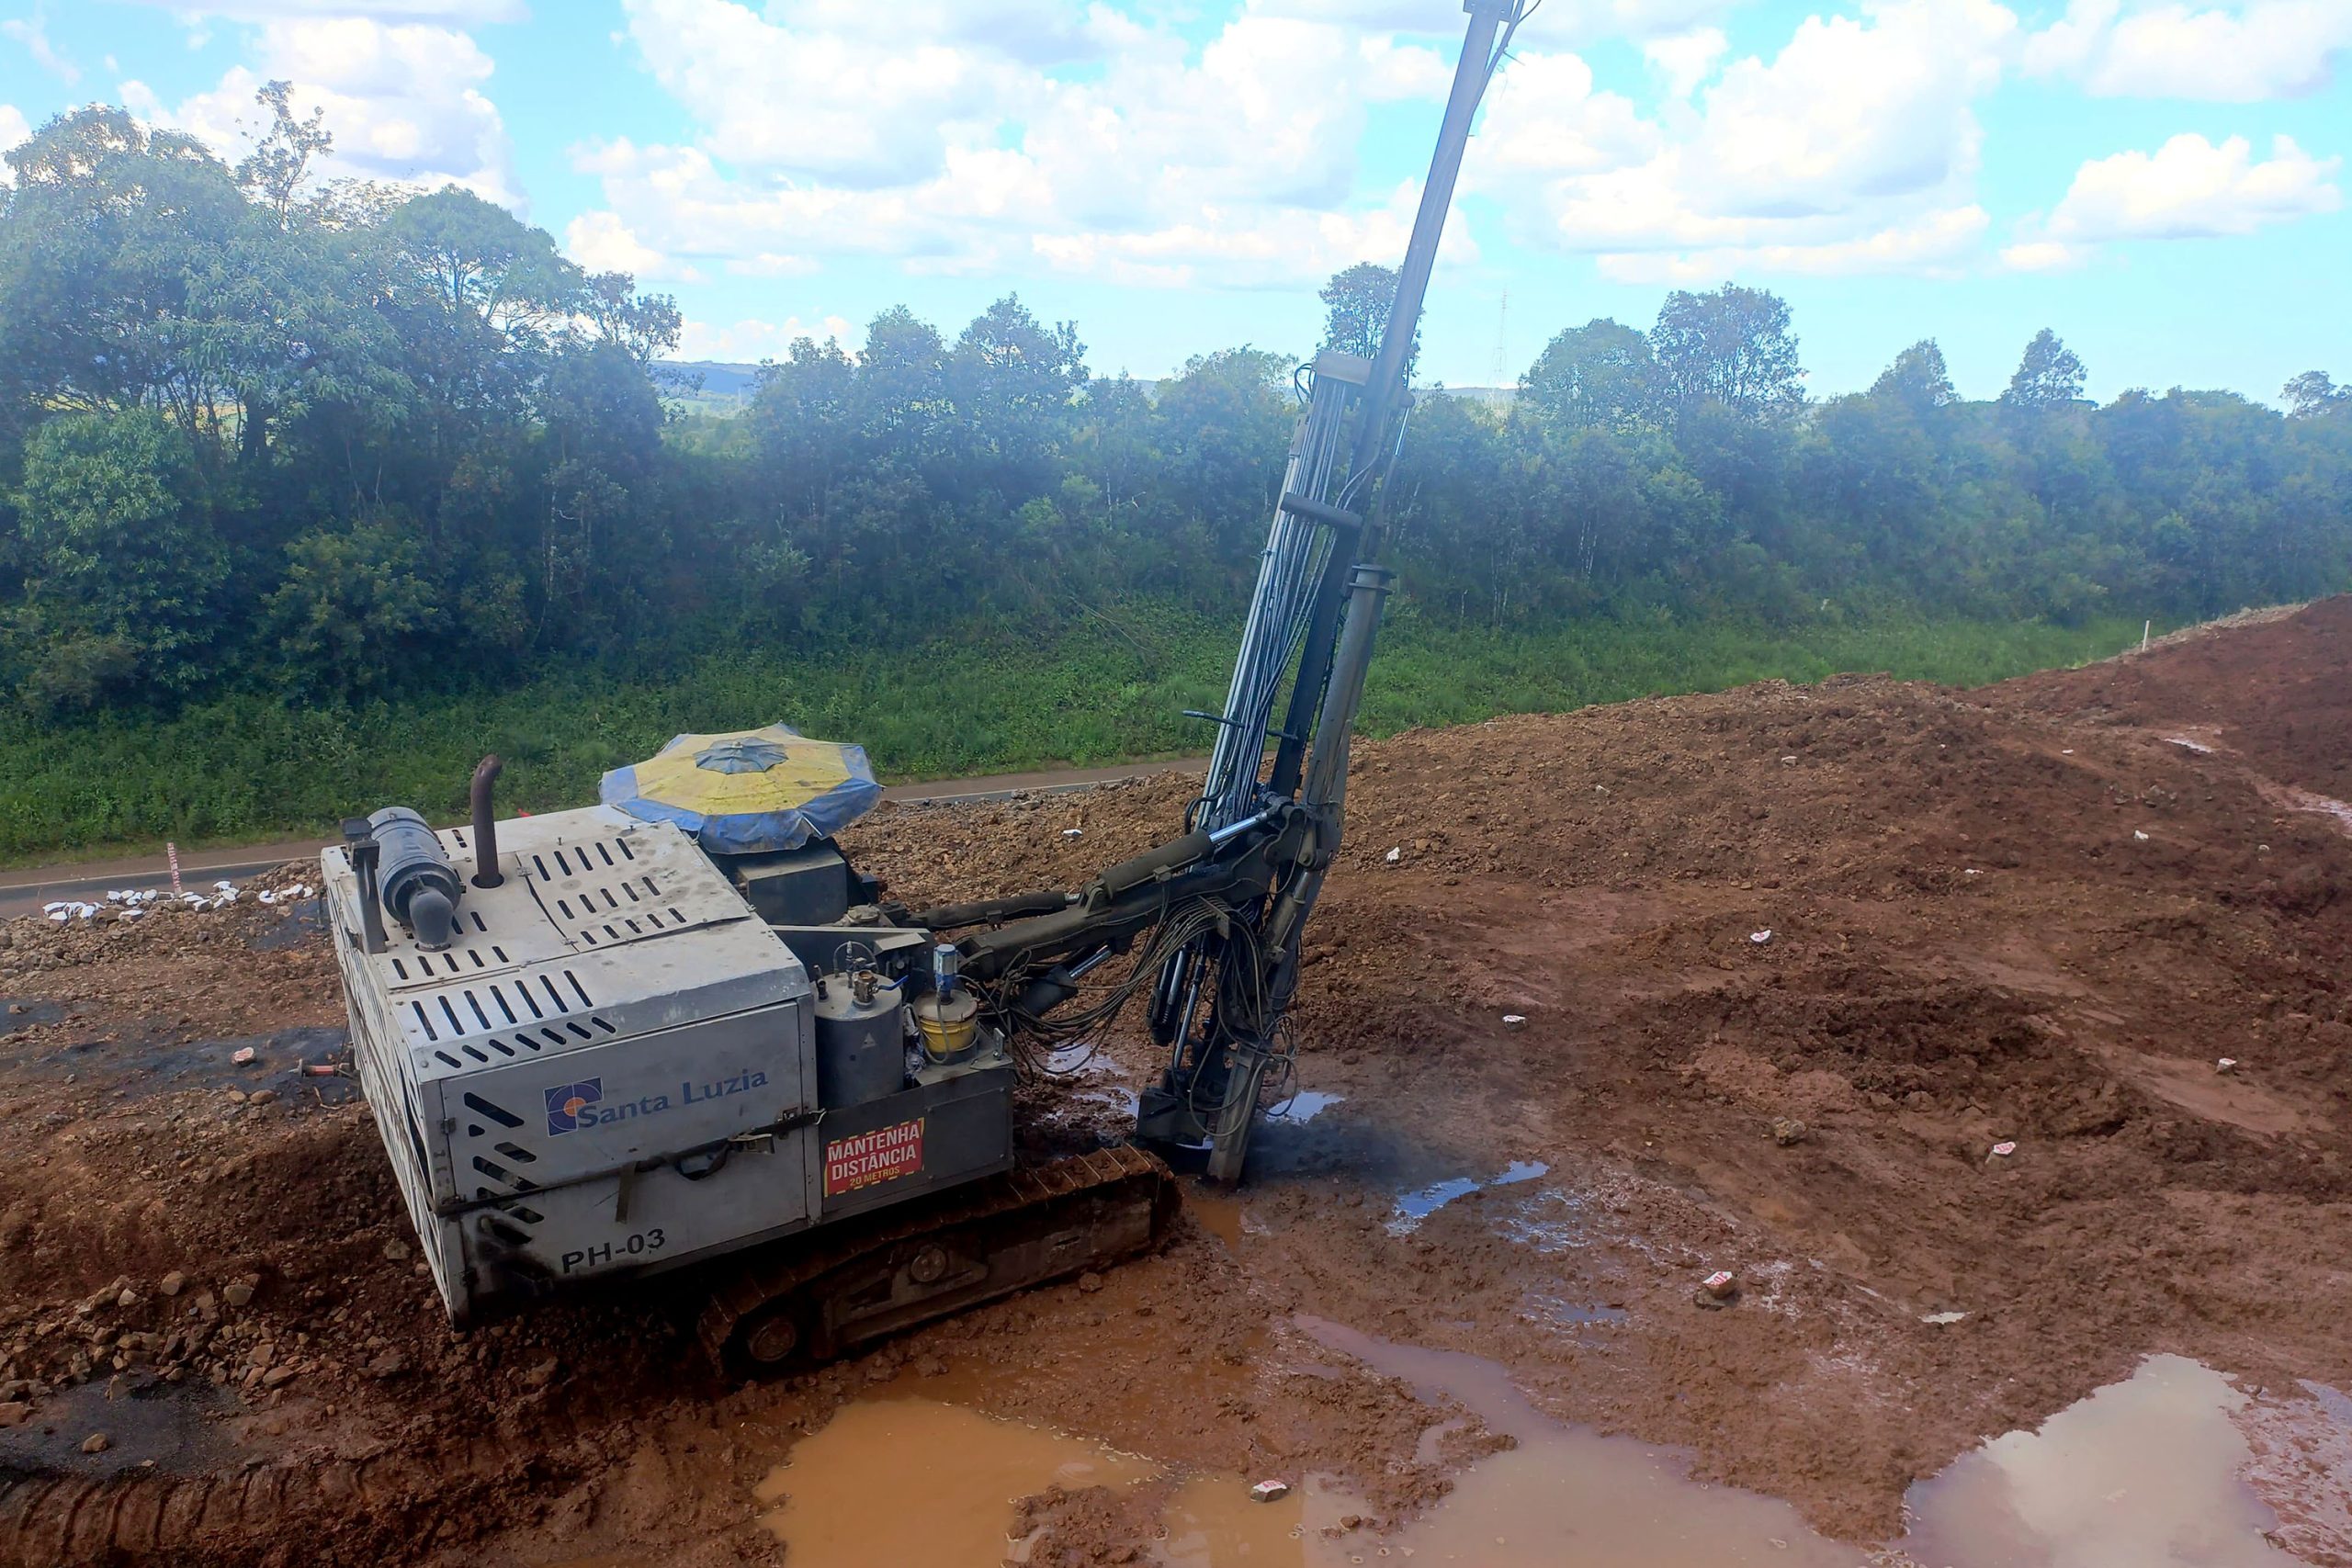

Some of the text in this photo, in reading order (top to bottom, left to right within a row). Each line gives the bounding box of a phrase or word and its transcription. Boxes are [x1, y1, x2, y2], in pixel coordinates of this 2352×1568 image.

[577, 1068, 769, 1129] Santa Luzia
[828, 1123, 920, 1162] MANTENHA
[831, 1144, 916, 1181] DISTÂNCIA
[849, 1166, 900, 1187] 20 METROS
[561, 1228, 665, 1274] PH-03
